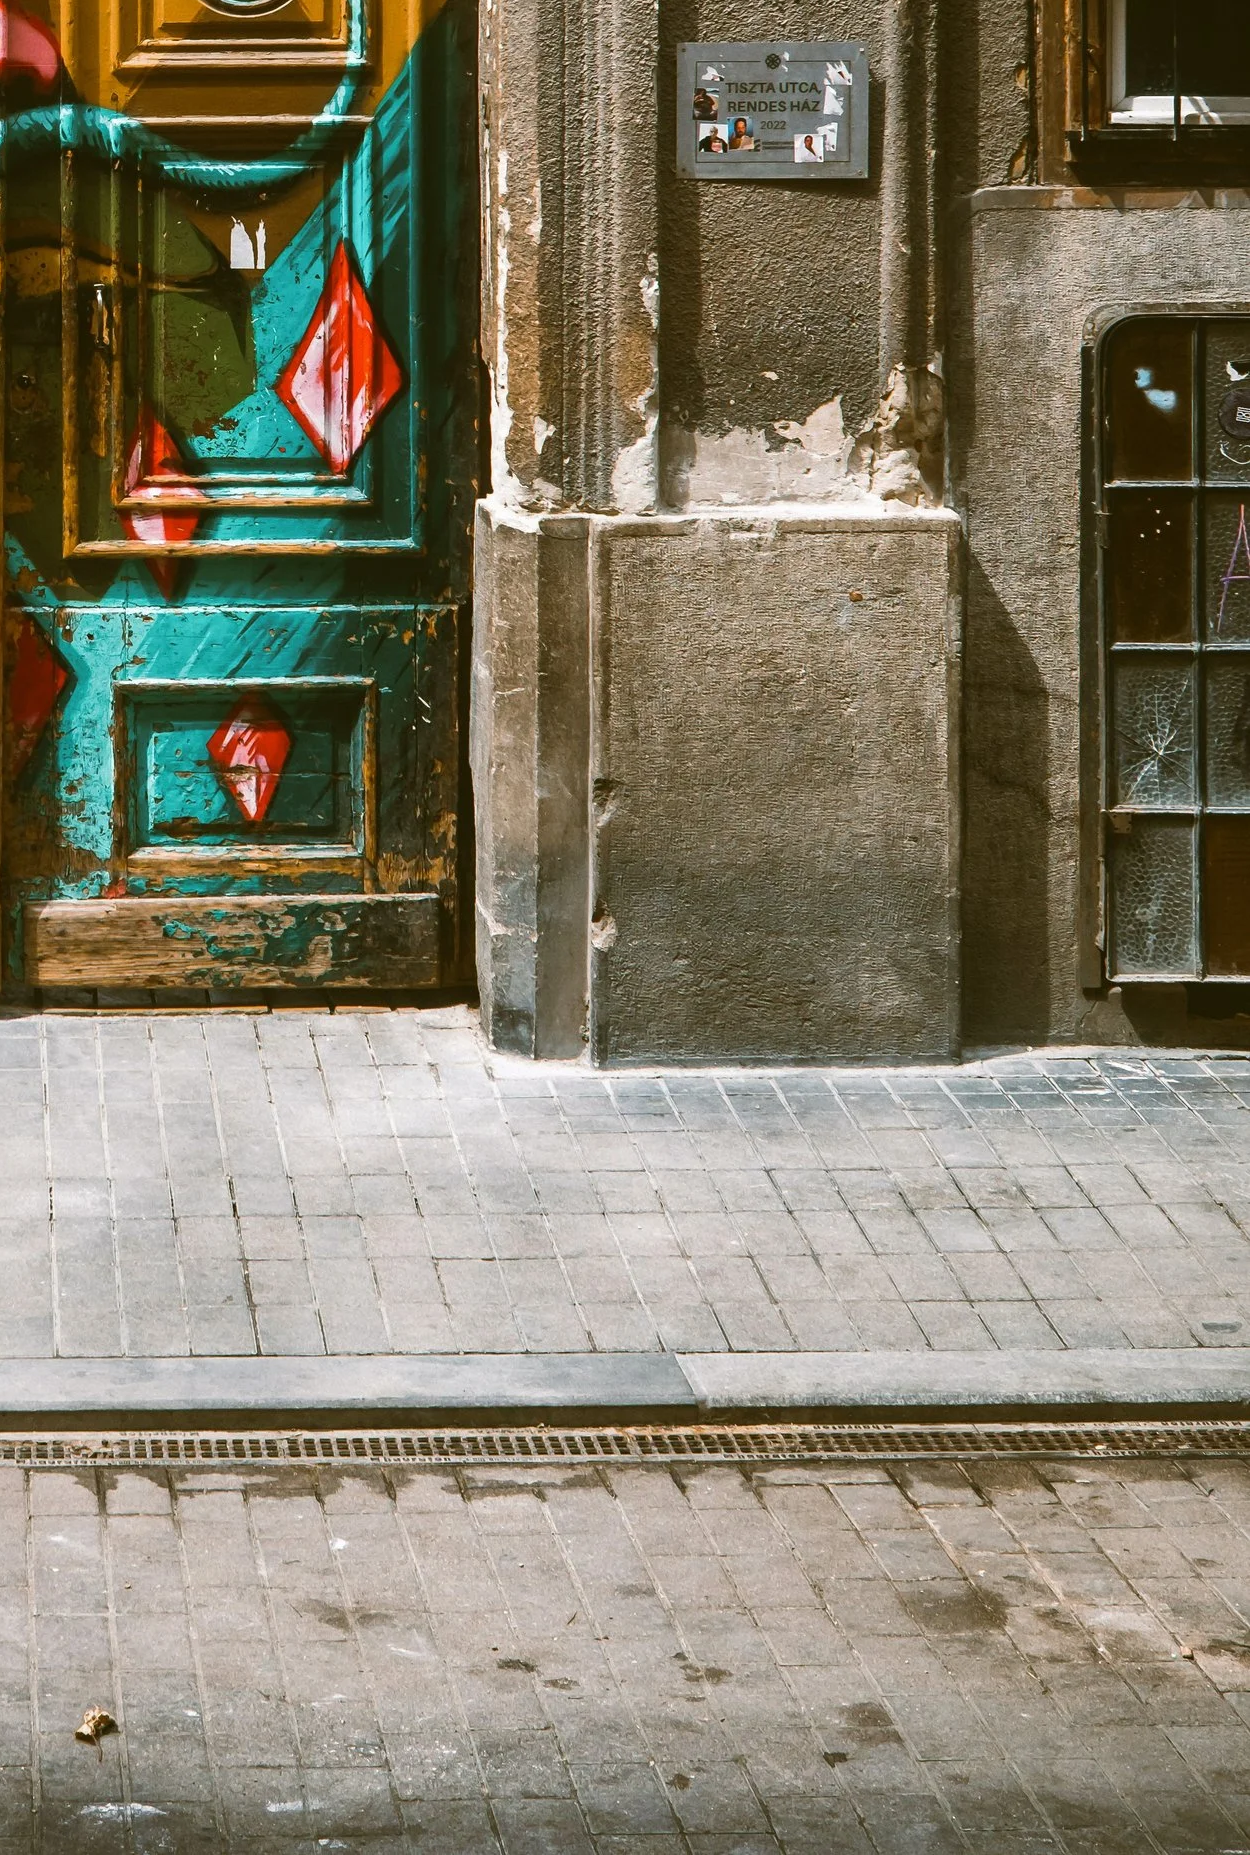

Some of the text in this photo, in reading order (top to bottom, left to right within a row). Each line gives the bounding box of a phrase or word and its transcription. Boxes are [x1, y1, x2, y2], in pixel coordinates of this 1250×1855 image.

[725, 82, 822, 95] TISZTA UTCA,
[727, 98, 821, 113] RENDES HÁZ
[760, 120, 787, 131] 2022
